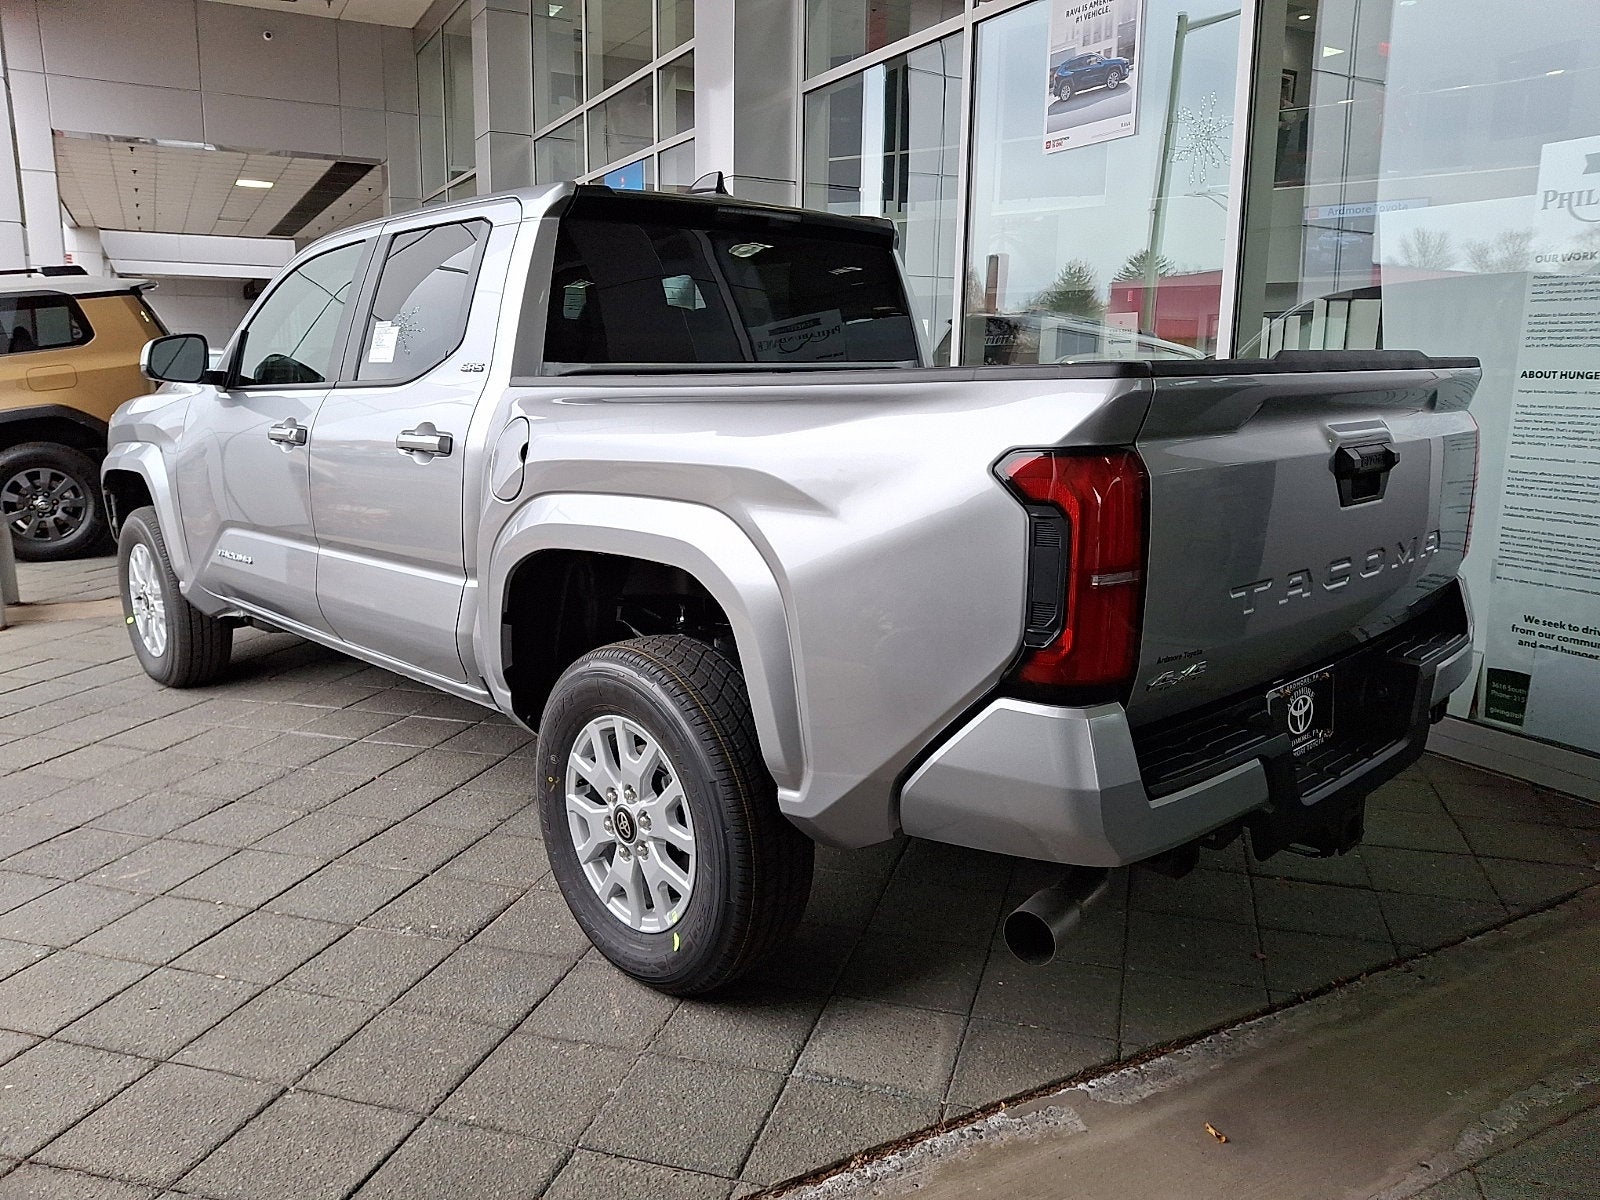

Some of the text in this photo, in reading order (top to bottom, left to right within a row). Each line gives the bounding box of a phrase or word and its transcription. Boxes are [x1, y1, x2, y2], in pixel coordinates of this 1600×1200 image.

[1066, 6, 1080, 18] RAV4
[1082, 4, 1088, 12] IS
[1075, 6, 1110, 24] #1 VEHICLE.
[1327, 206, 1372, 217] Ardmore
[1535, 250, 1598, 264] OUR WORK
[1520, 370, 1558, 379] ABOUT
[1229, 529, 1441, 615] TACOMA
[1524, 615, 1540, 624] We
[1542, 619, 1566, 630] seek
[1568, 623, 1580, 632] to
[1511, 624, 1536, 636] from
[1538, 630, 1556, 640] our
[1518, 639, 1537, 648] and
[1157, 649, 1203, 664] Ardmore Toyota
[1291, 732, 1312, 747] DMORE,
